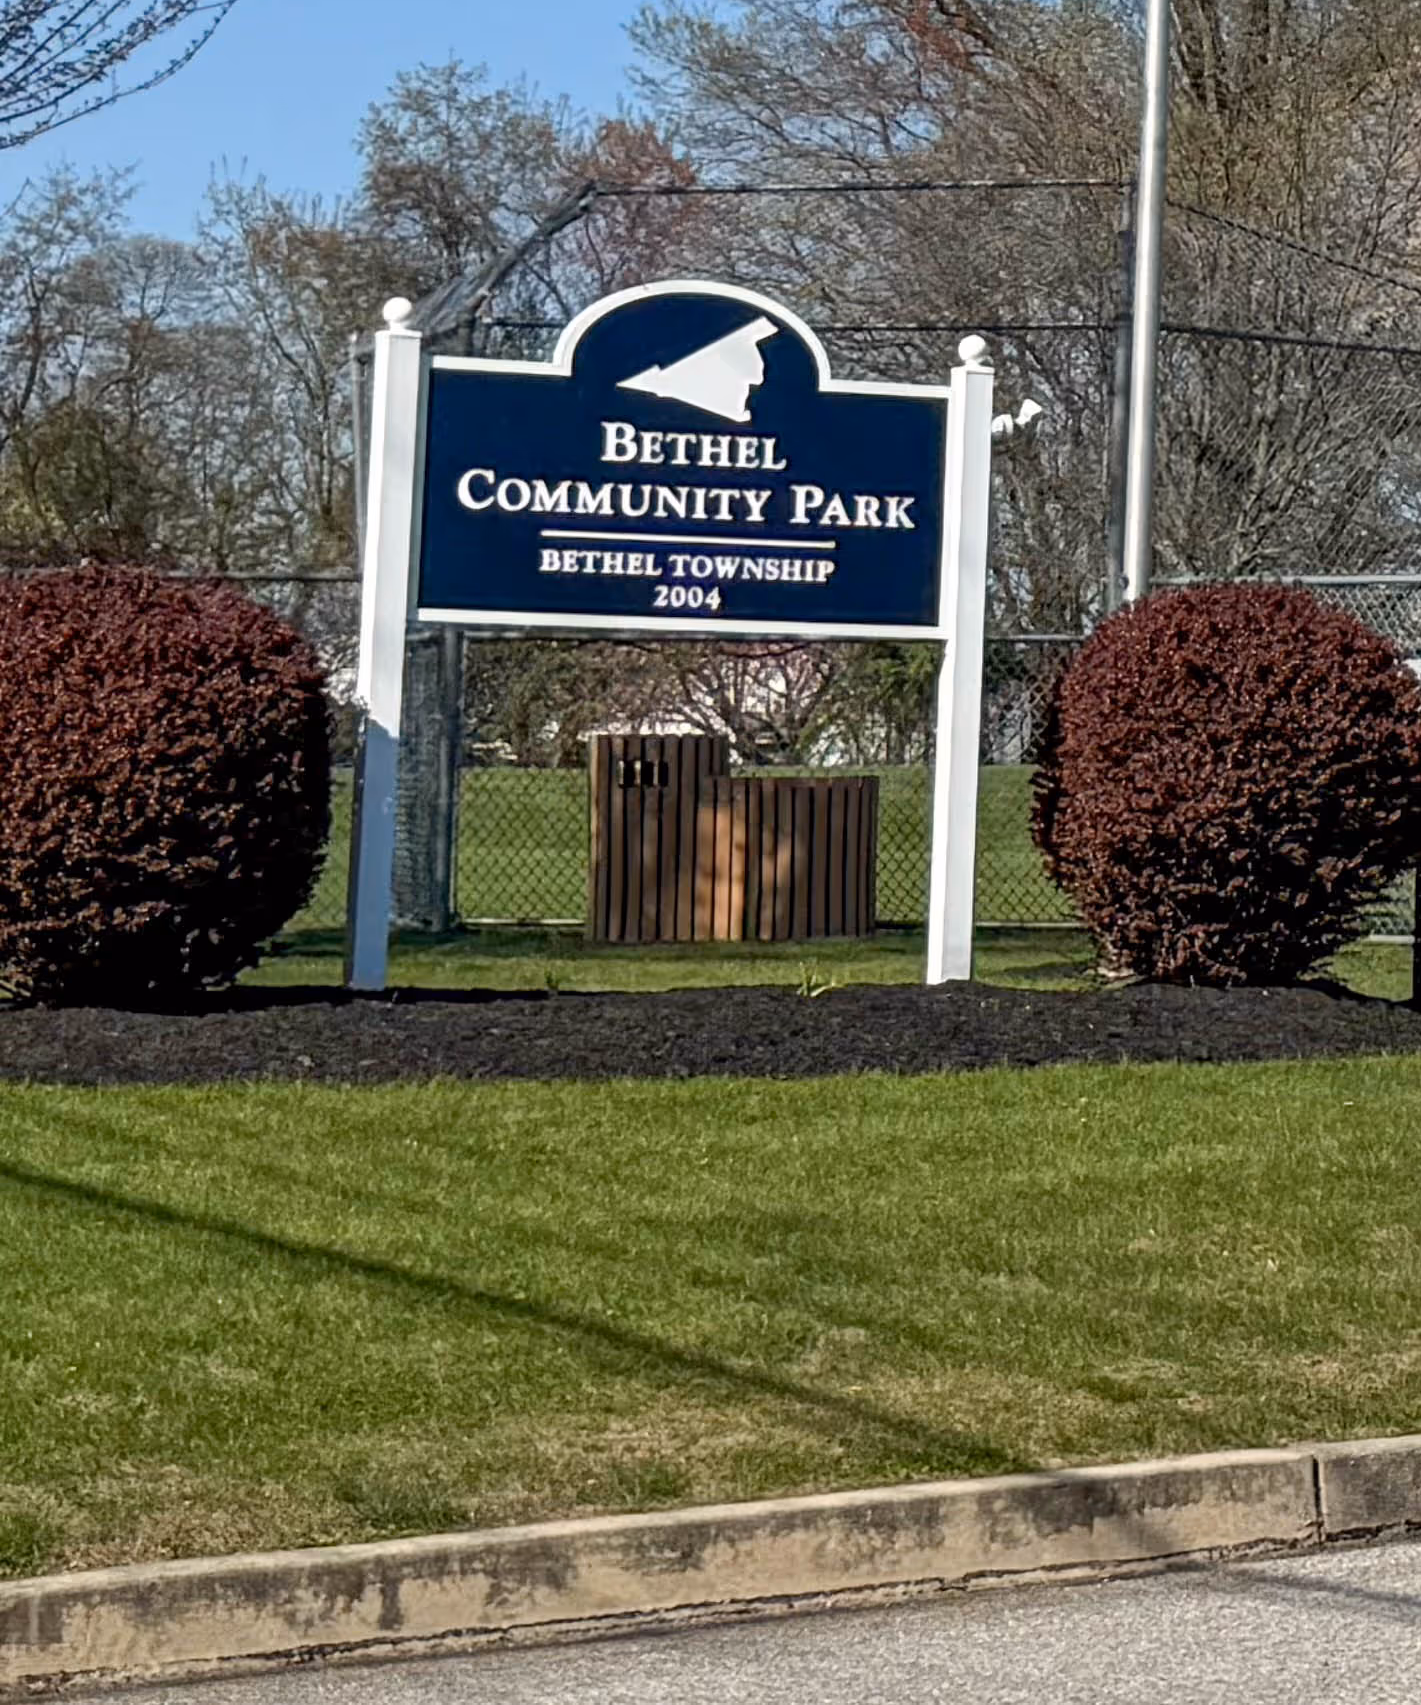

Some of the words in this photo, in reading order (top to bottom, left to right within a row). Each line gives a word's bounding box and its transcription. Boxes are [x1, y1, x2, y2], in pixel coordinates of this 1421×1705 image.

[600, 421, 787, 471] BETHEL
[457, 468, 772, 523] COMMUNITY
[789, 485, 916, 530] PARK
[539, 548, 662, 576] BETHEL
[668, 554, 836, 583] TOWNSHIP
[653, 585, 722, 611] 2004
